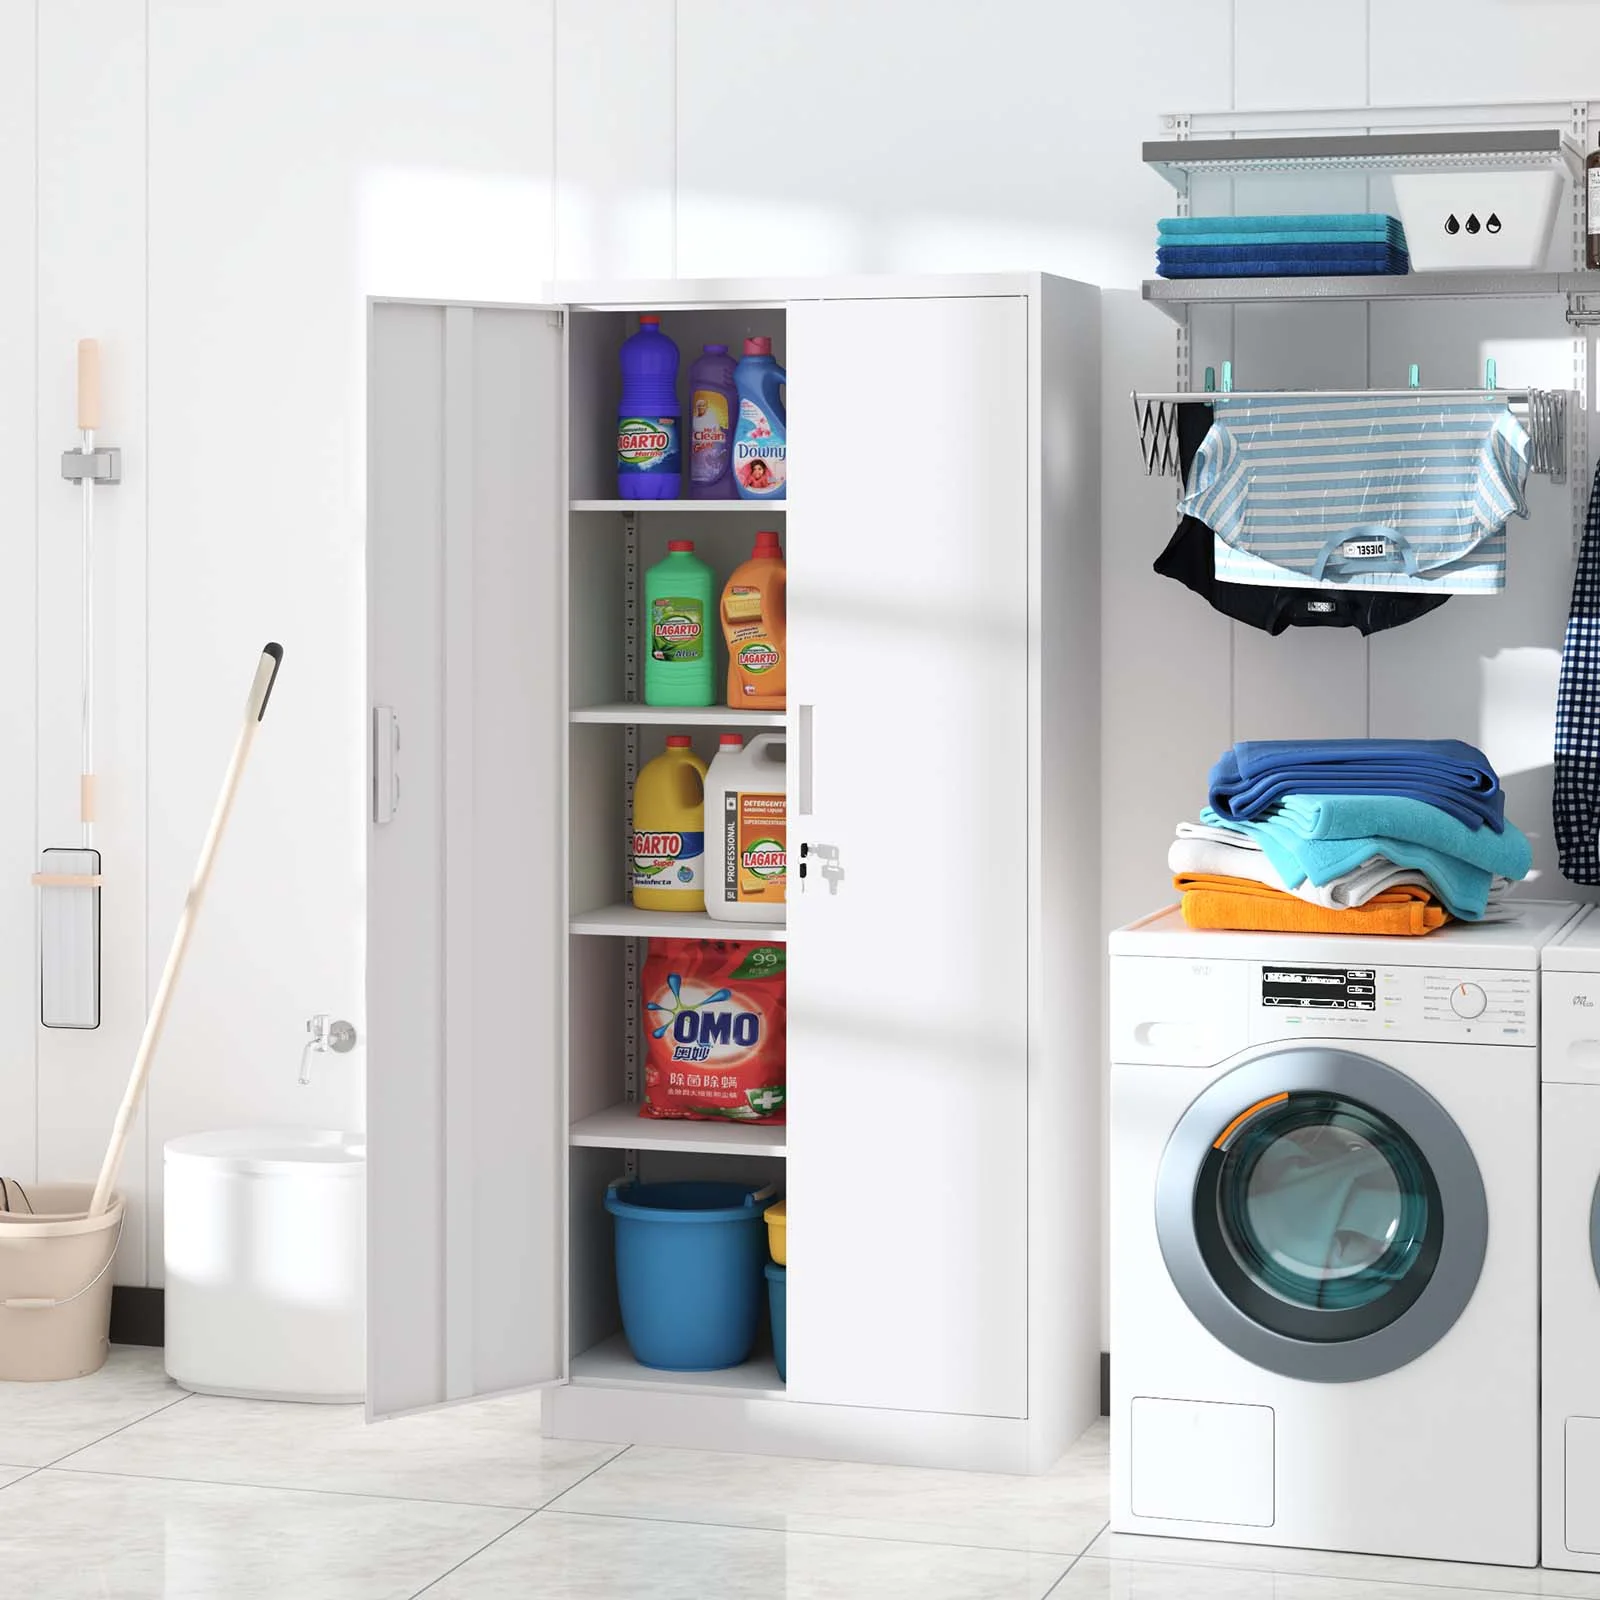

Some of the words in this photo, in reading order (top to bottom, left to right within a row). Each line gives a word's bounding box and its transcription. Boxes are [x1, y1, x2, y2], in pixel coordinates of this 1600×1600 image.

[694, 431, 725, 441] Clean
[738, 444, 786, 461] Downy
[1357, 544, 1383, 555] DIESEL
[655, 624, 699, 636] LAGARTO
[739, 653, 778, 664] LAGARTO
[727, 822, 736, 882] PROFESSIONAL
[752, 953, 777, 967] 99
[673, 1010, 760, 1047] OMO
[672, 1046, 712, 1061] 奥妙
[670, 1072, 738, 1089] 除菌除螨
